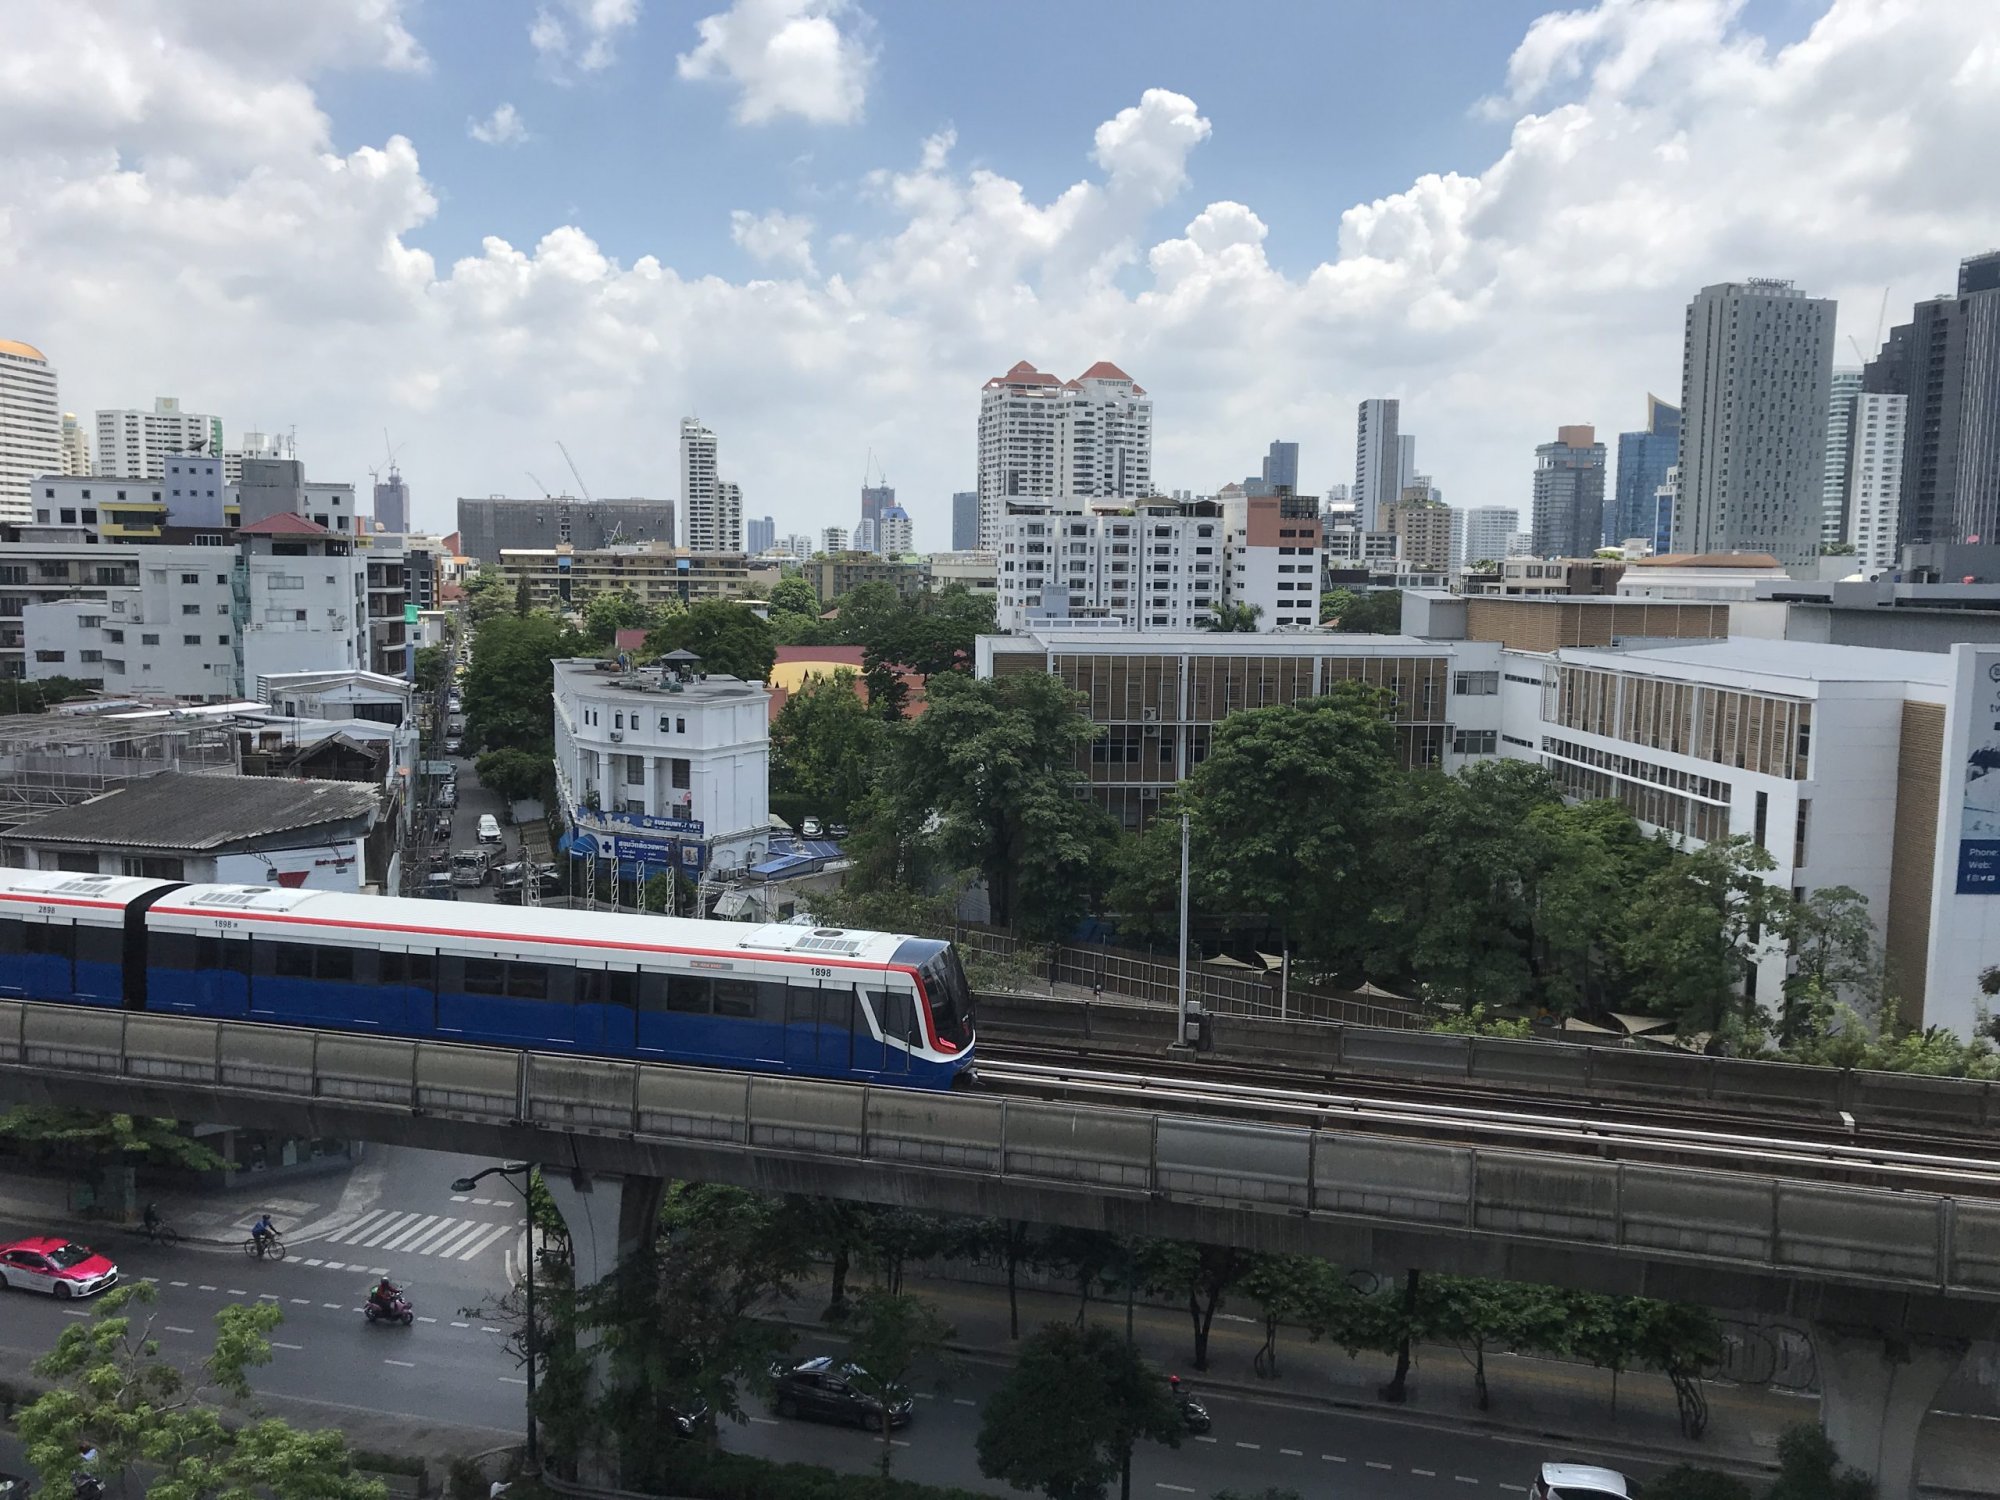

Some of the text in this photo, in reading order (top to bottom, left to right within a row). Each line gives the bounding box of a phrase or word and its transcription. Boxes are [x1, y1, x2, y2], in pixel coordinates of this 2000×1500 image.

[1748, 277, 1795, 289] SOMERSET
[1969, 861, 1992, 869] Web:
[38, 906, 55, 914] 2898
[214, 920, 232, 928] 1898
[811, 967, 831, 977] 1898
